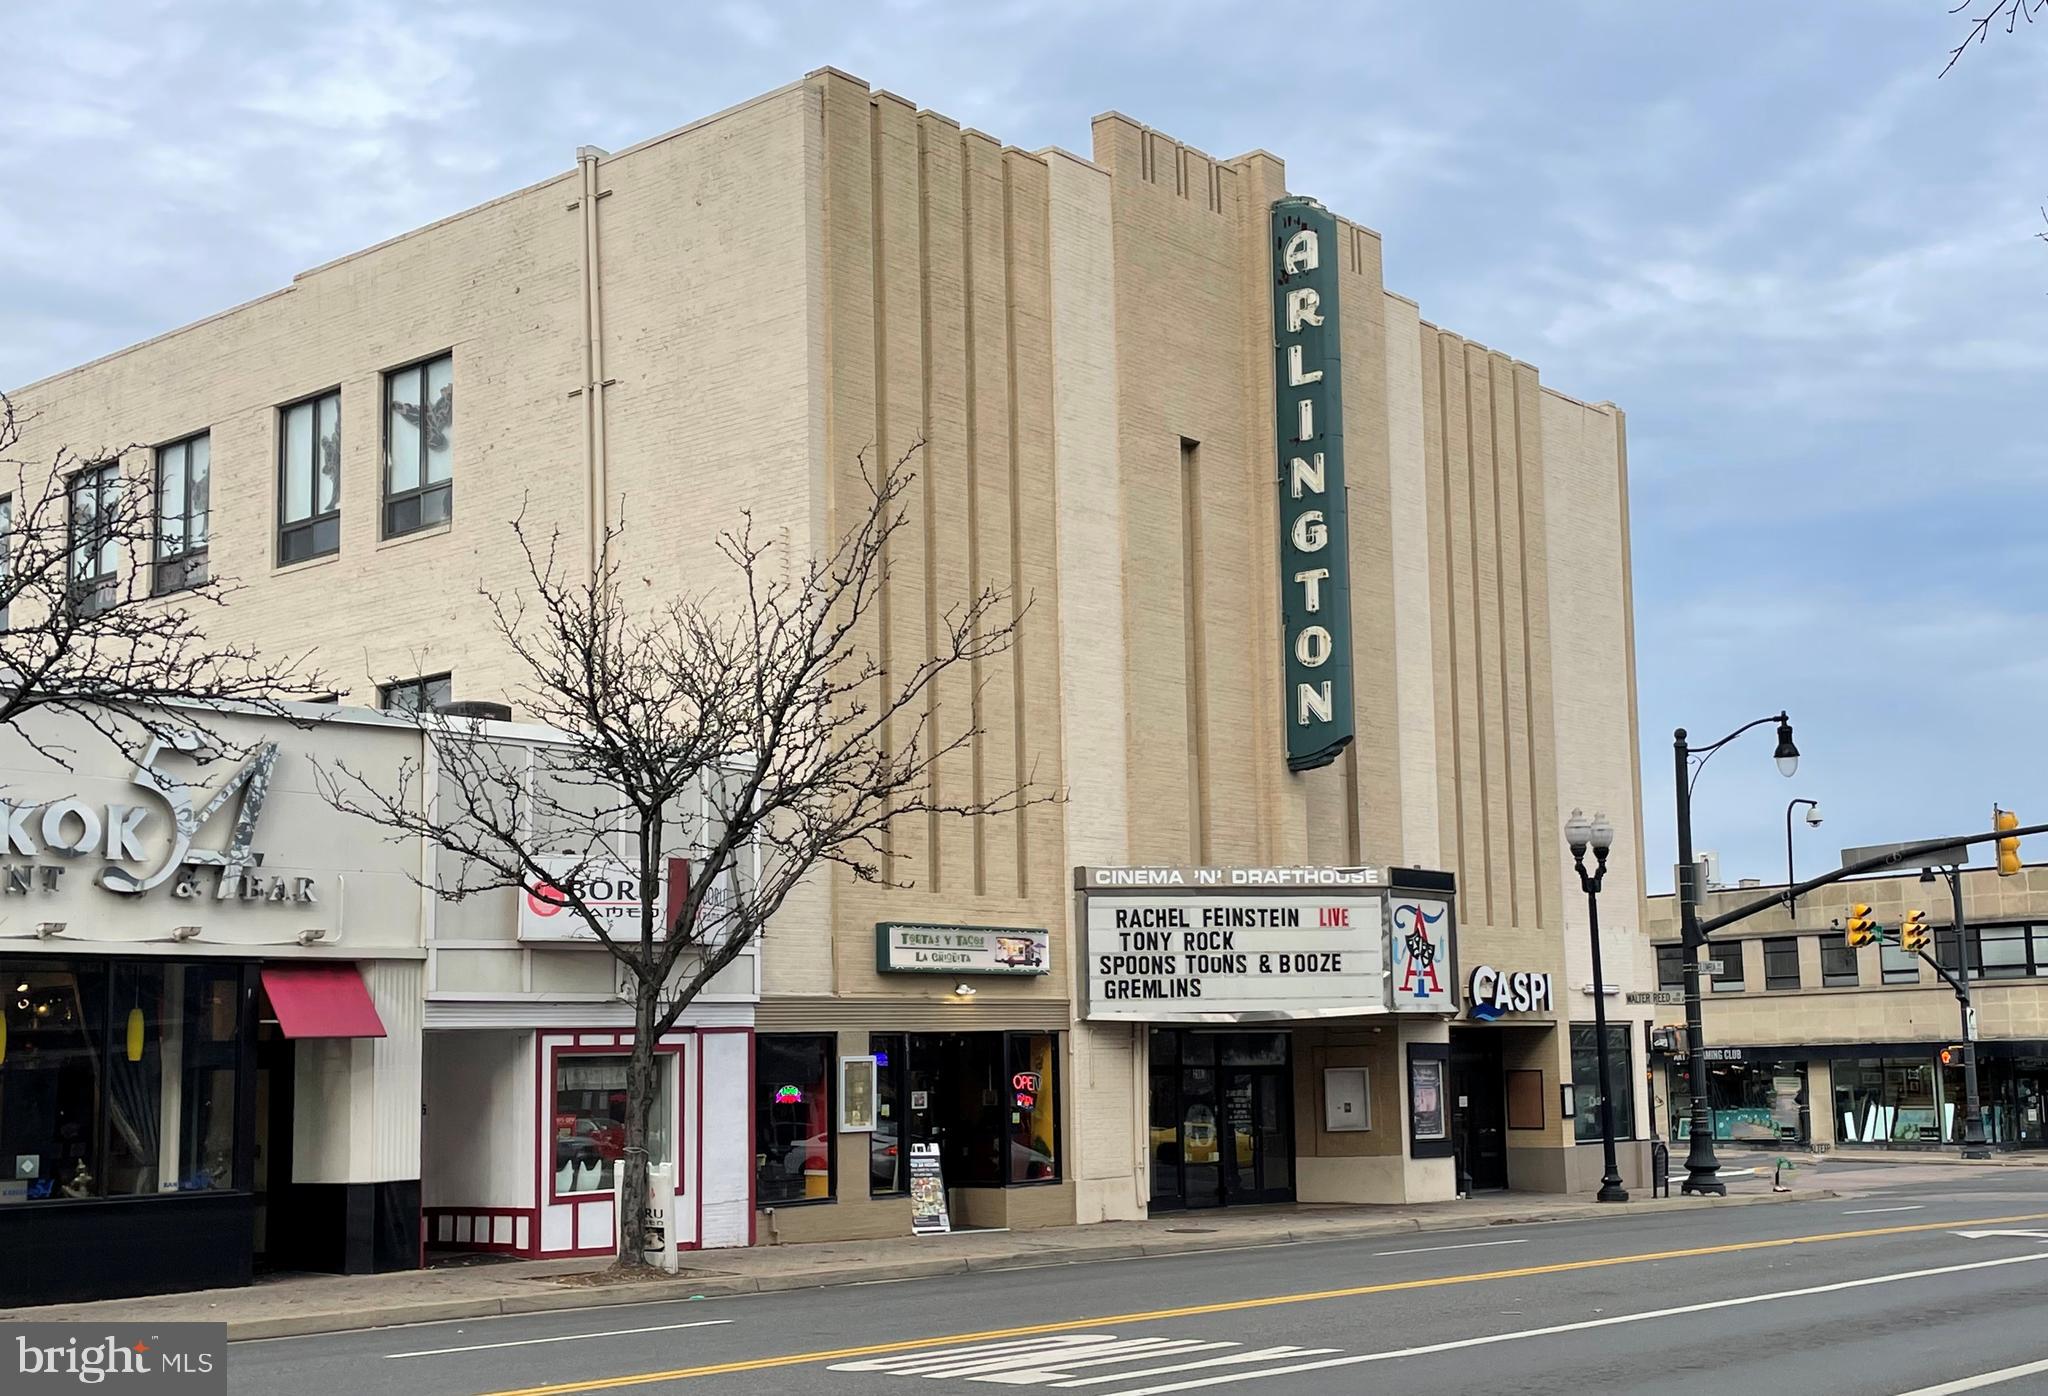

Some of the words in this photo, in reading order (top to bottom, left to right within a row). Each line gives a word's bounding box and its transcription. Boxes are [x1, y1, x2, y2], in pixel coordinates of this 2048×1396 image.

[1284, 229, 1332, 726] ARLINGTON
[102, 730, 279, 900] 54
[1095, 870, 1184, 884] CINEMA
[1232, 870, 1378, 884] DRAFTHOUSE
[1116, 908, 1190, 928] RACHEL
[1203, 908, 1299, 928] FEINSTEIN
[1320, 908, 1349, 927] LIVE
[901, 933, 940, 946] TORTAS
[944, 934, 951, 945] Y
[956, 935, 985, 947] TACOS
[1119, 932, 1172, 951] TONY
[1184, 931, 1234, 951] ROCK
[1100, 956, 1176, 975] SPOONS
[1186, 954, 1247, 974] TOONS
[1259, 955, 1272, 973] &
[1279, 954, 1341, 973] BOOZE
[1104, 979, 1201, 999] GREMLINS
[1471, 965, 1553, 1012] CASPI
[1653, 992, 1671, 1003] REED
[1724, 1049, 1742, 1060] CLUB
[1013, 1075, 1041, 1091] OPEN
